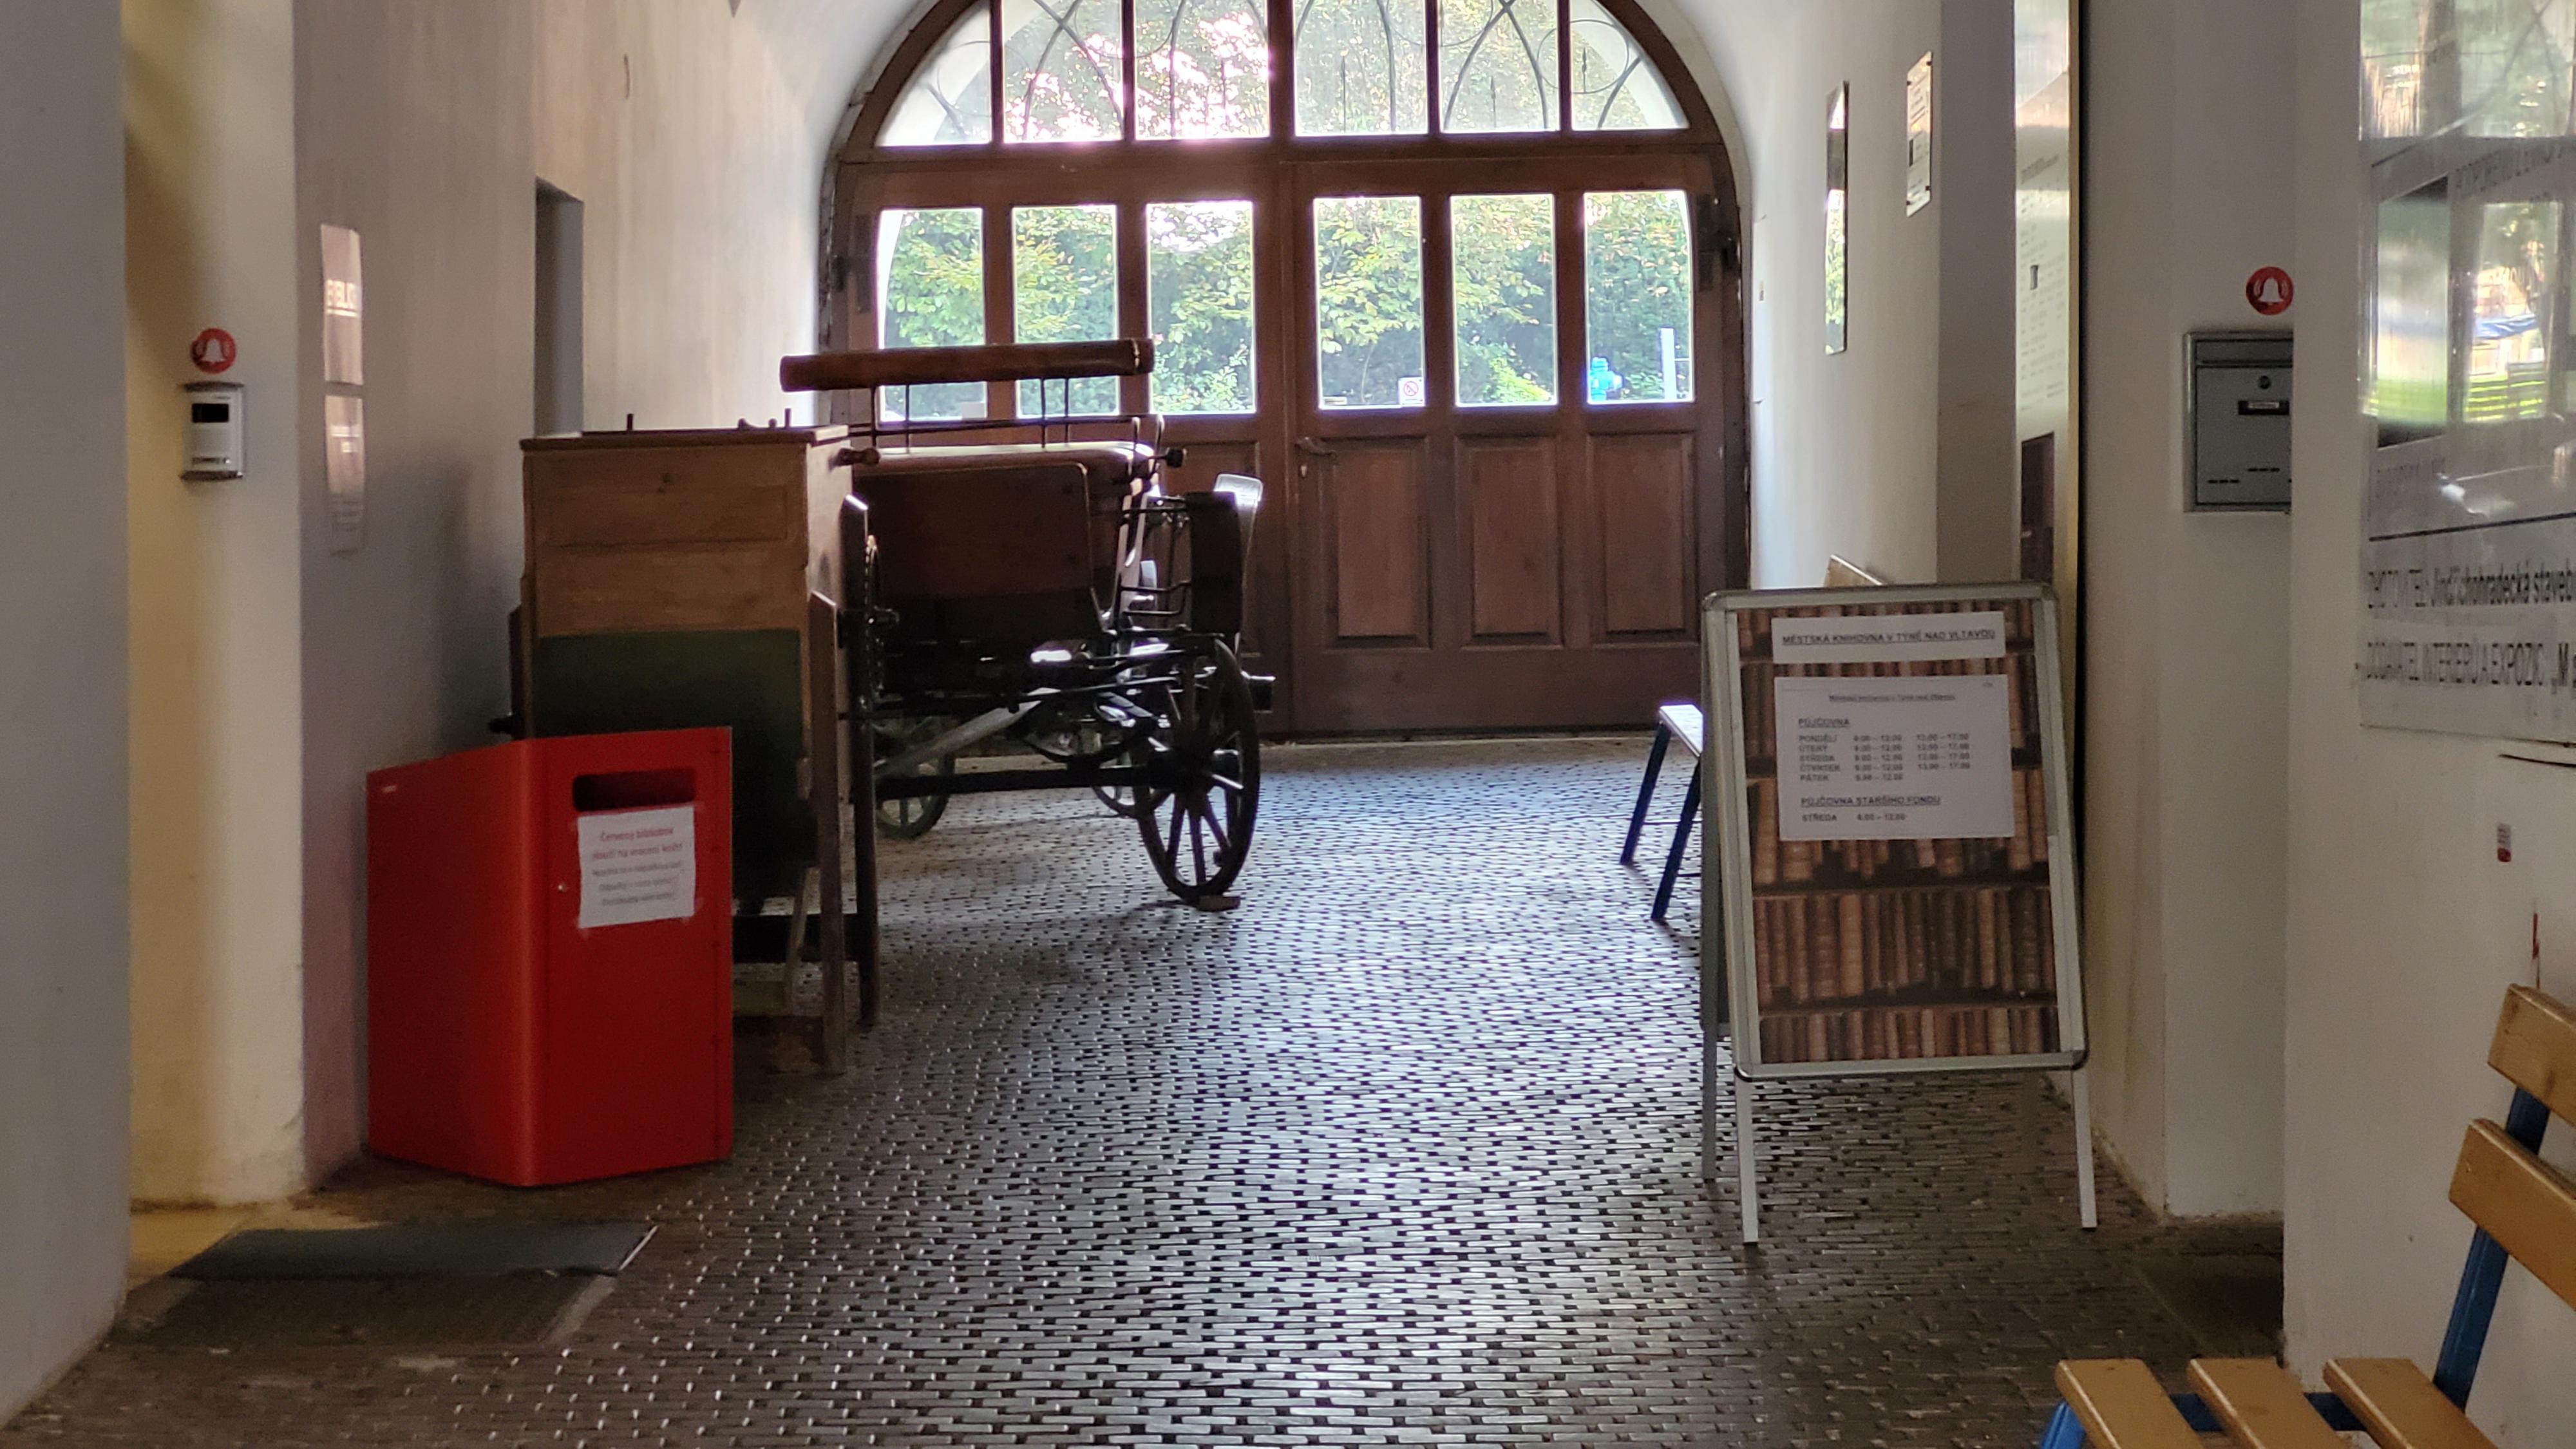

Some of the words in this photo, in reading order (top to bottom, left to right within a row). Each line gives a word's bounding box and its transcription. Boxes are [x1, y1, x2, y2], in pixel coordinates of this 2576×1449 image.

[1783, 633, 1830, 645] MĚSTSKÁ
[1833, 633, 1884, 644] KNIHOVNA
[1886, 633, 1893, 642] V
[1925, 631, 1946, 641] NAD
[1949, 629, 1995, 640] VLTAVOU
[1801, 796, 1853, 807] PŮJČOVNA
